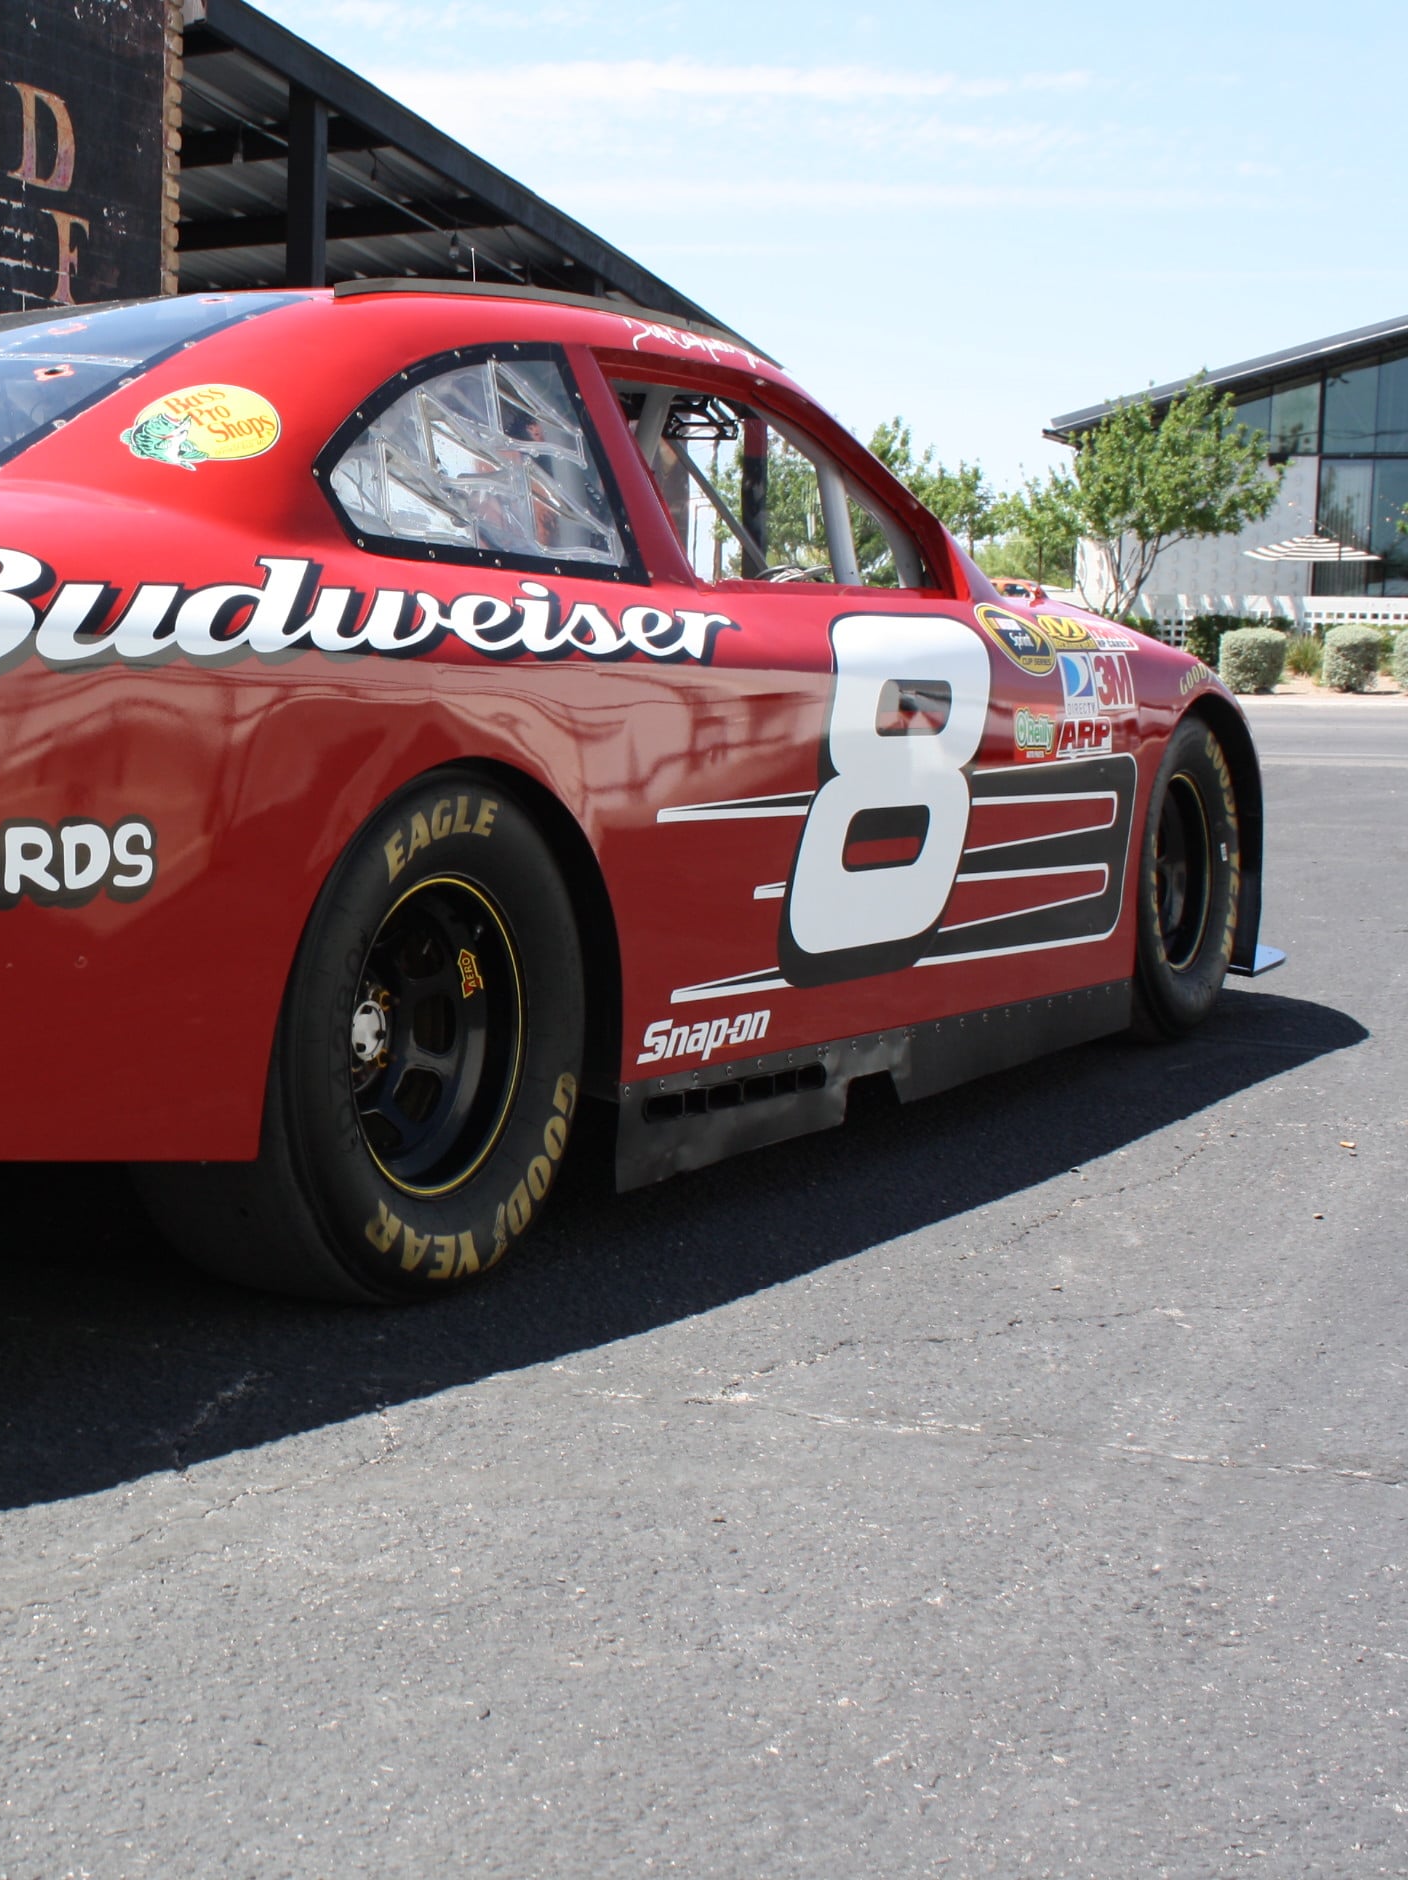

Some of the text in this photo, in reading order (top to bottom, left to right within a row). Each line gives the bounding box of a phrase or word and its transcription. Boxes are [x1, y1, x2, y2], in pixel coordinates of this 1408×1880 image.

[7, 82, 76, 192] D
[42, 209, 90, 305] F
[164, 387, 226, 415] Bass
[188, 404, 231, 427] Pro
[207, 415, 276, 443] Shops
[1093, 655, 1134, 706] 3M
[1058, 719, 1111, 751] ARP
[786, 613, 992, 958] 8
[383, 796, 500, 884] EAGLE
[637, 1010, 771, 1064] Snap-on
